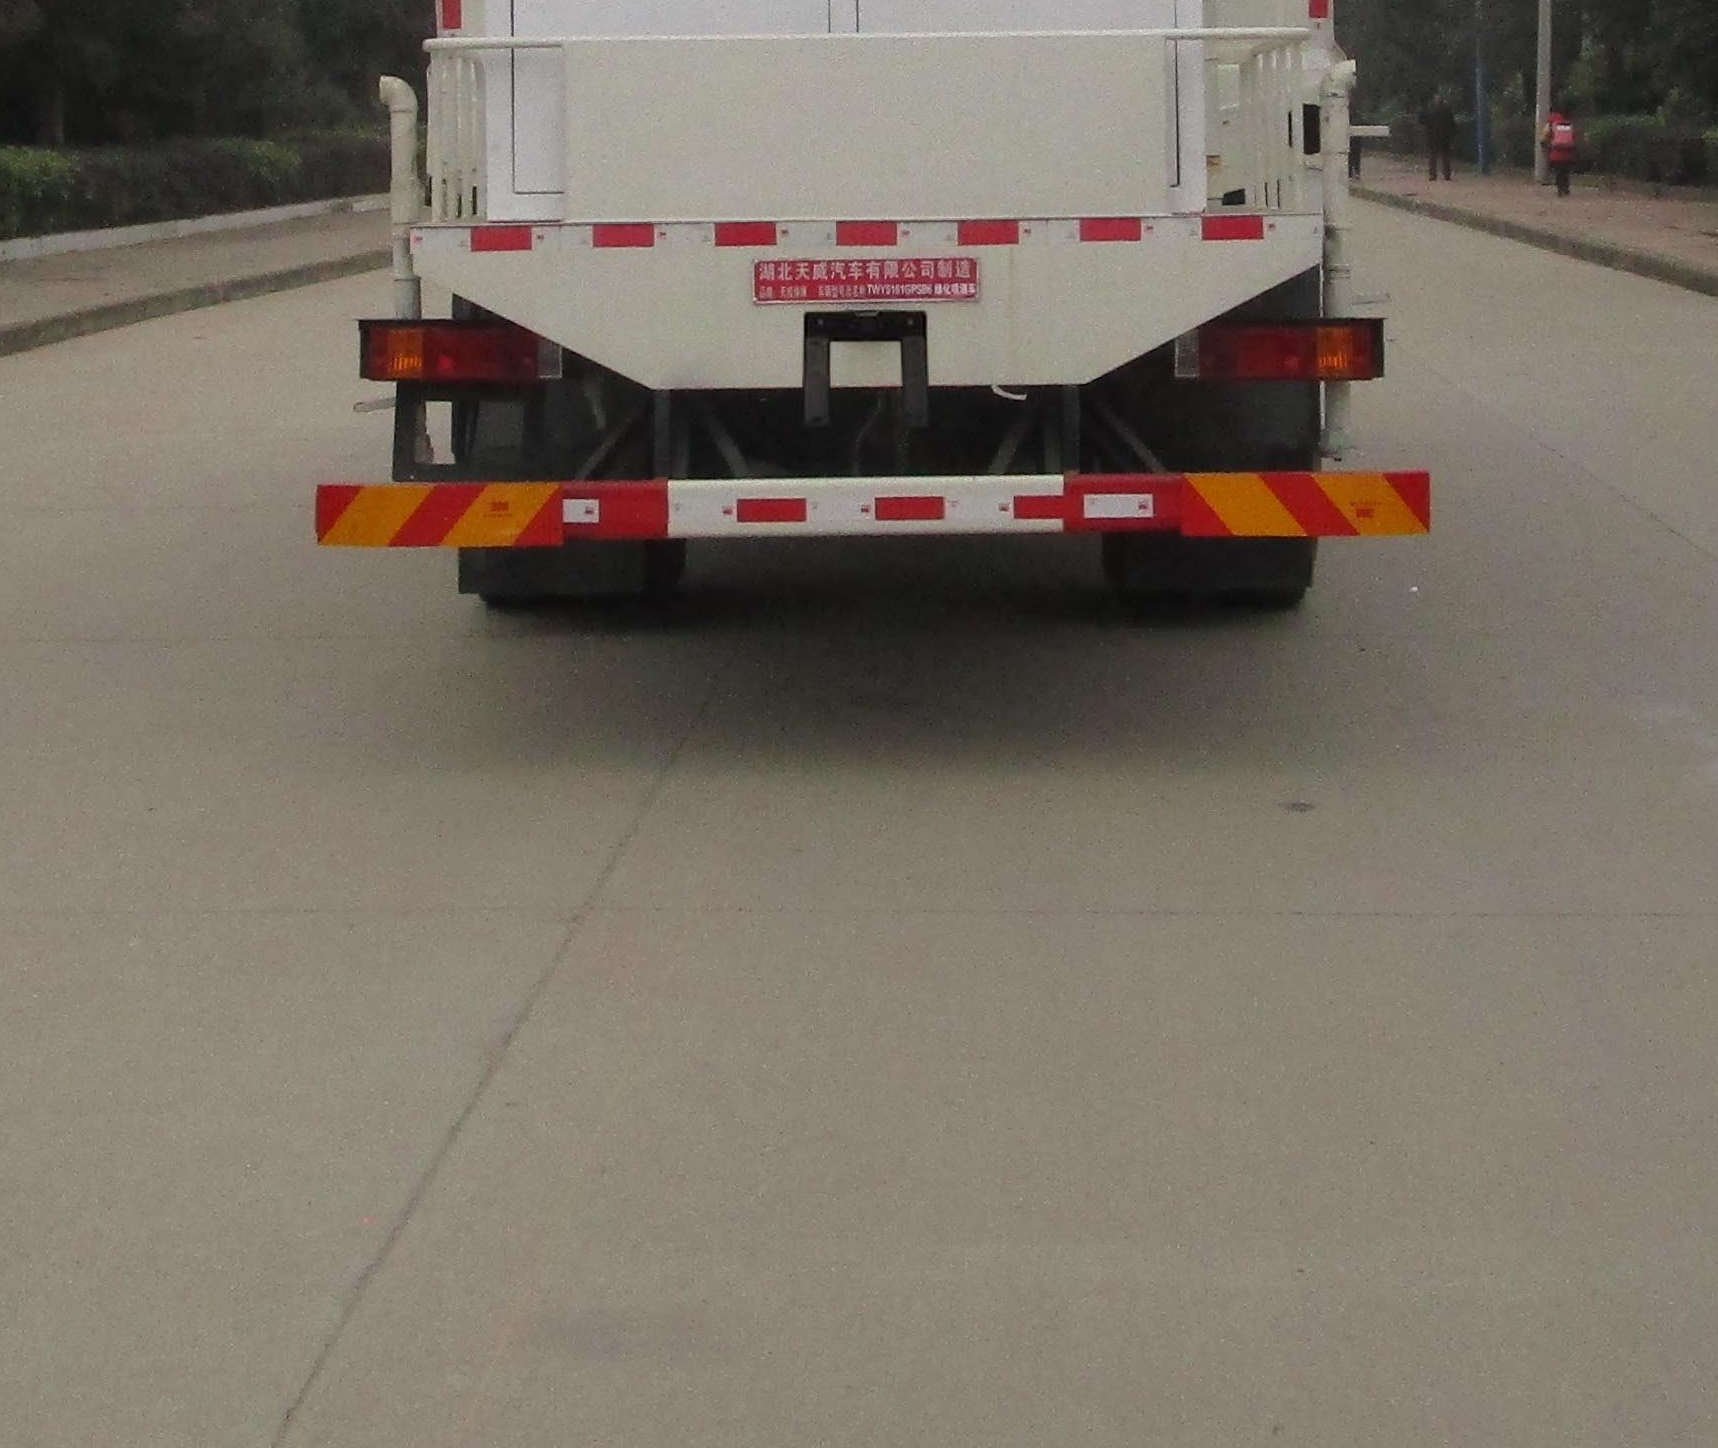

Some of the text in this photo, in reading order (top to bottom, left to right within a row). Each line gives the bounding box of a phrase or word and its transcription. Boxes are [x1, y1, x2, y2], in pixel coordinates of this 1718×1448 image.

[759, 259, 971, 281] 湖北天威汽车有限公司制造
